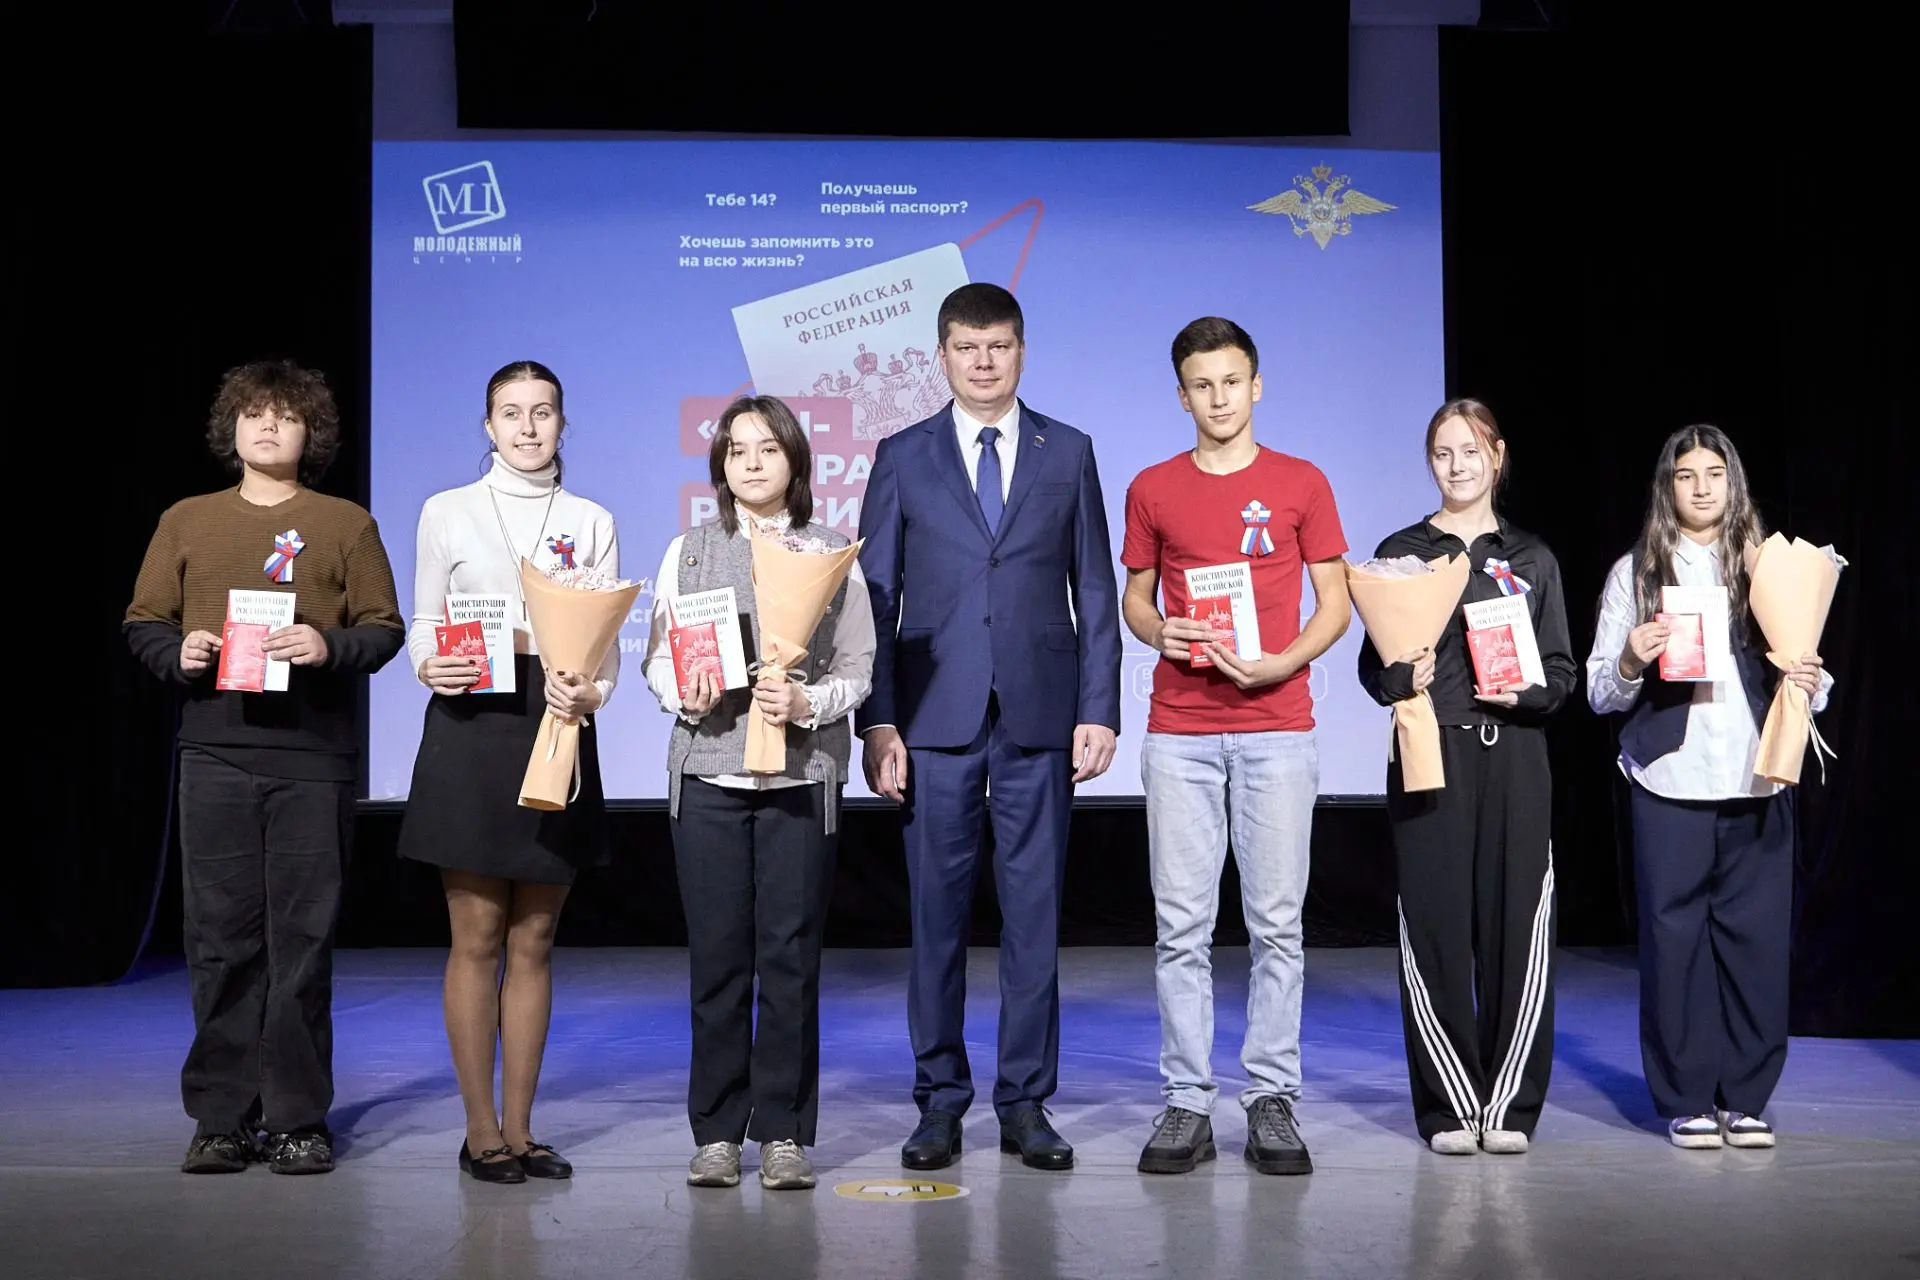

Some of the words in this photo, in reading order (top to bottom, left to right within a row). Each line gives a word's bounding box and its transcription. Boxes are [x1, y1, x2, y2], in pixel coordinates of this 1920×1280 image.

[820, 181, 918, 197] Получаешь
[705, 193, 746, 207] Тебе
[750, 193, 777, 207] 14?
[820, 201, 886, 216] первый
[890, 201, 968, 216] паспорт?
[413, 233, 522, 255] МОЛОДЕЖНЫЙ
[679, 235, 746, 249] Хочешь
[750, 237, 841, 249] запомнить
[845, 237, 874, 249] это
[679, 256, 699, 268] на
[703, 256, 737, 268] всю
[741, 254, 805, 268] жизнь?
[782, 278, 914, 329] РОССИЙСКАЯ
[798, 300, 912, 345] ФЕДЕРАЦИЯ
[451, 599, 507, 609] КОНСТИТУЦИЯ
[454, 609, 505, 620] РОССИЙСКОЙ
